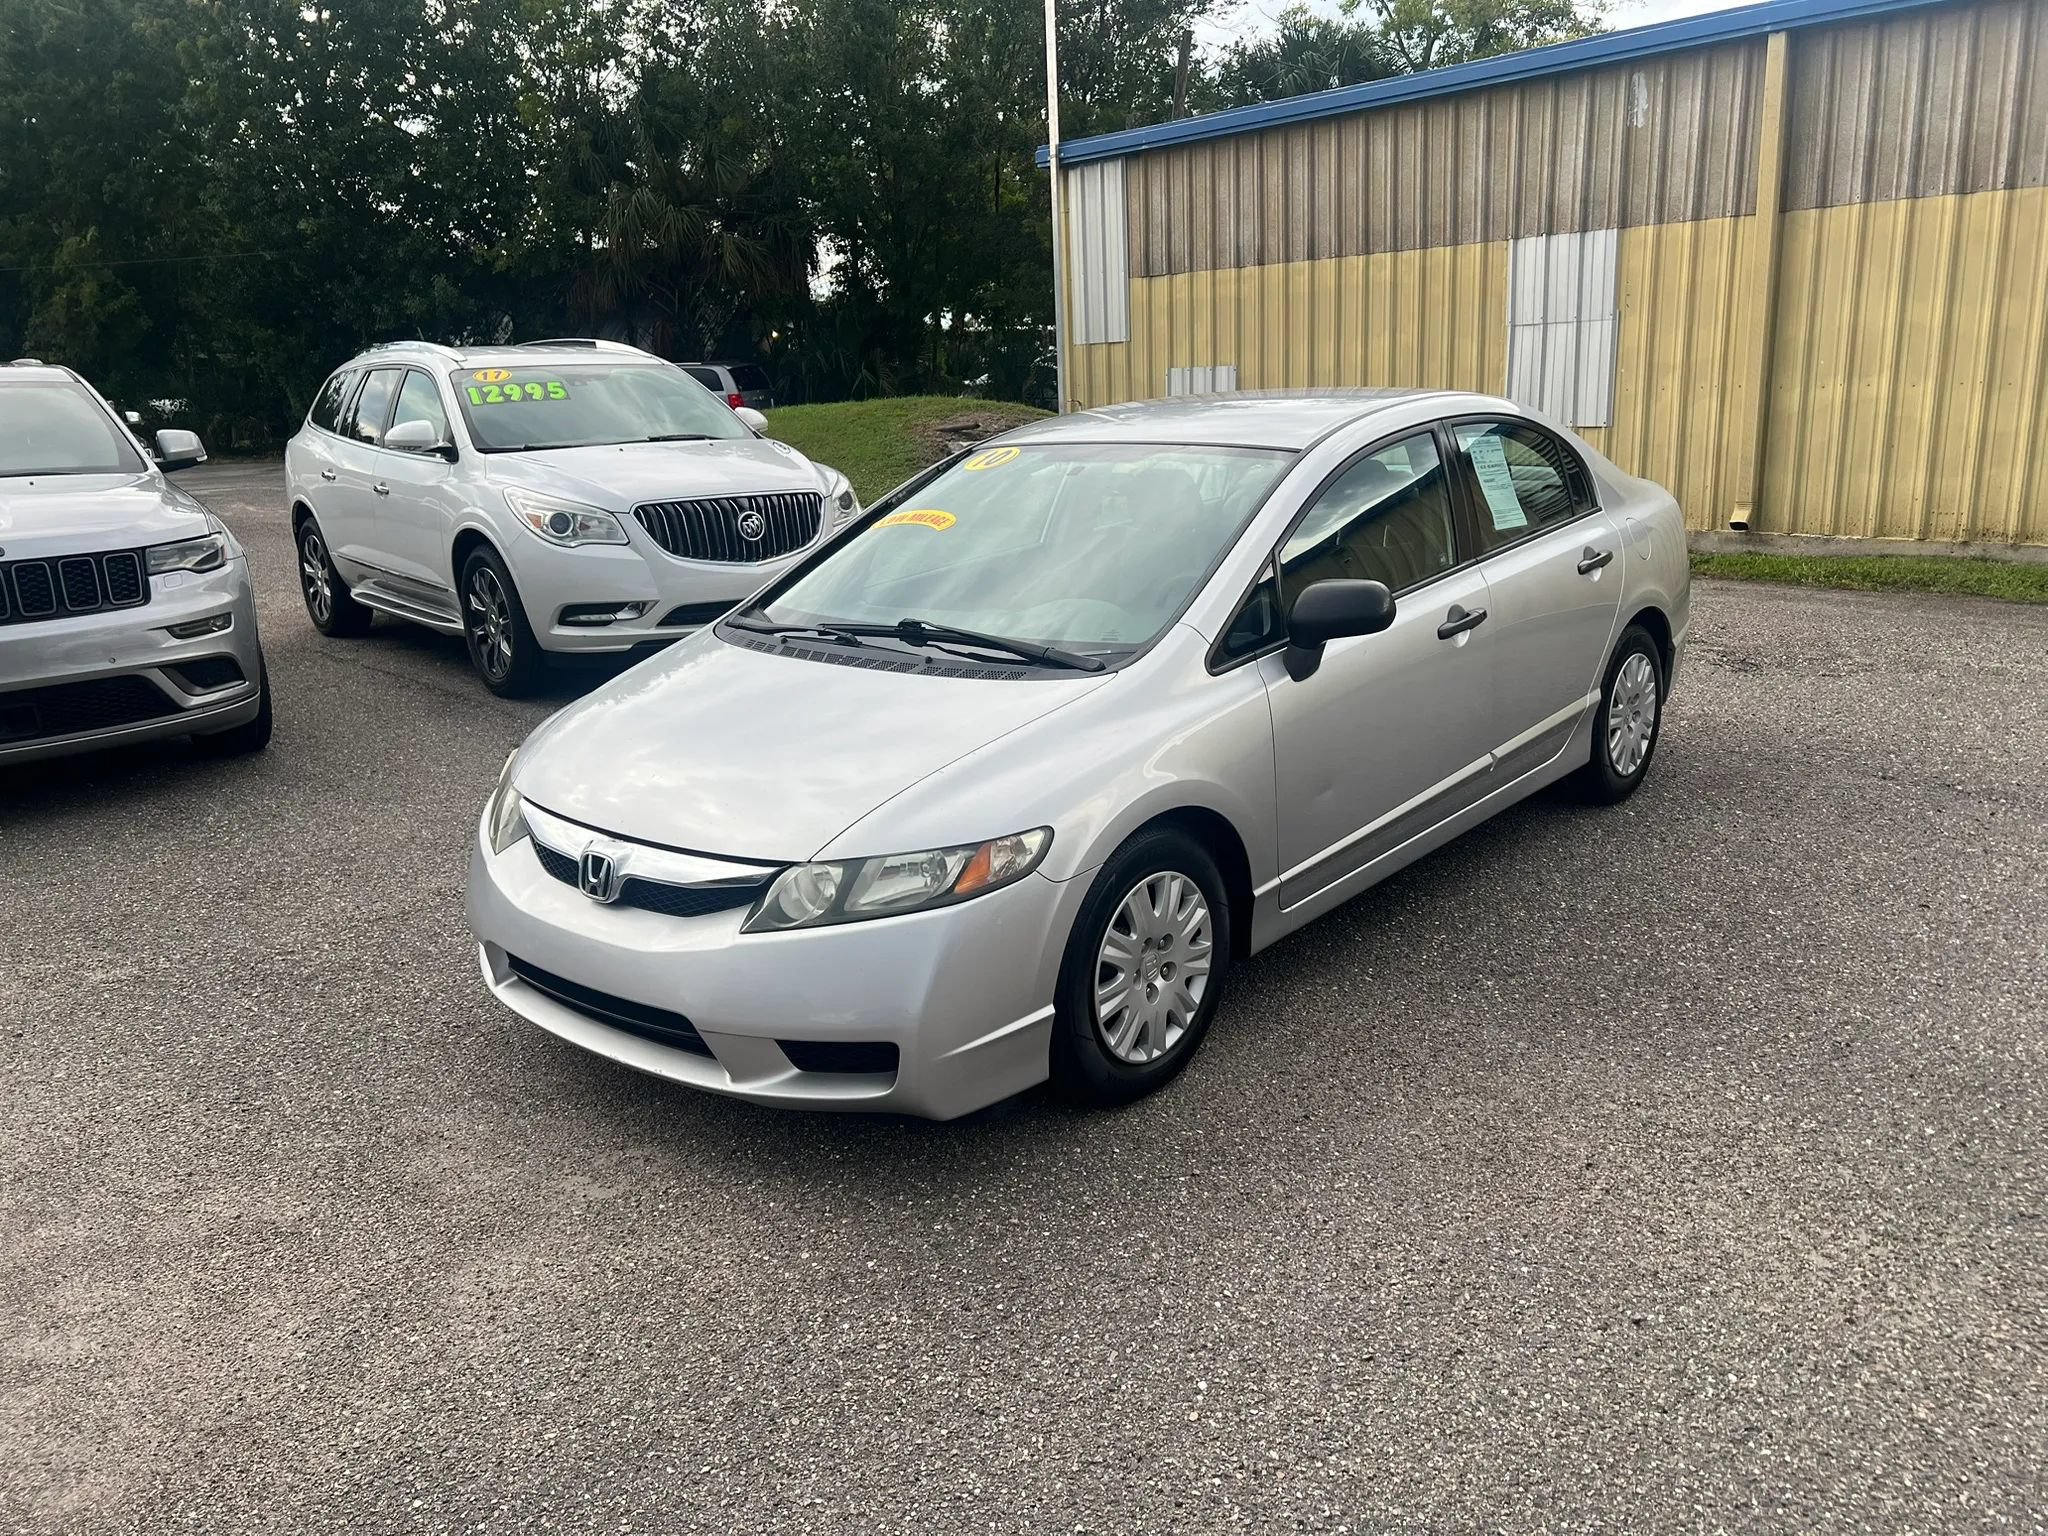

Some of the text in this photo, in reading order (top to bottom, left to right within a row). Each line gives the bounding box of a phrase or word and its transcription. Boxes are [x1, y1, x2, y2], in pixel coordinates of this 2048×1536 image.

[481, 370, 502, 380] 17
[467, 381, 568, 405] 12995
[971, 449, 1013, 467] 10
[911, 512, 951, 527] MILEAGE
